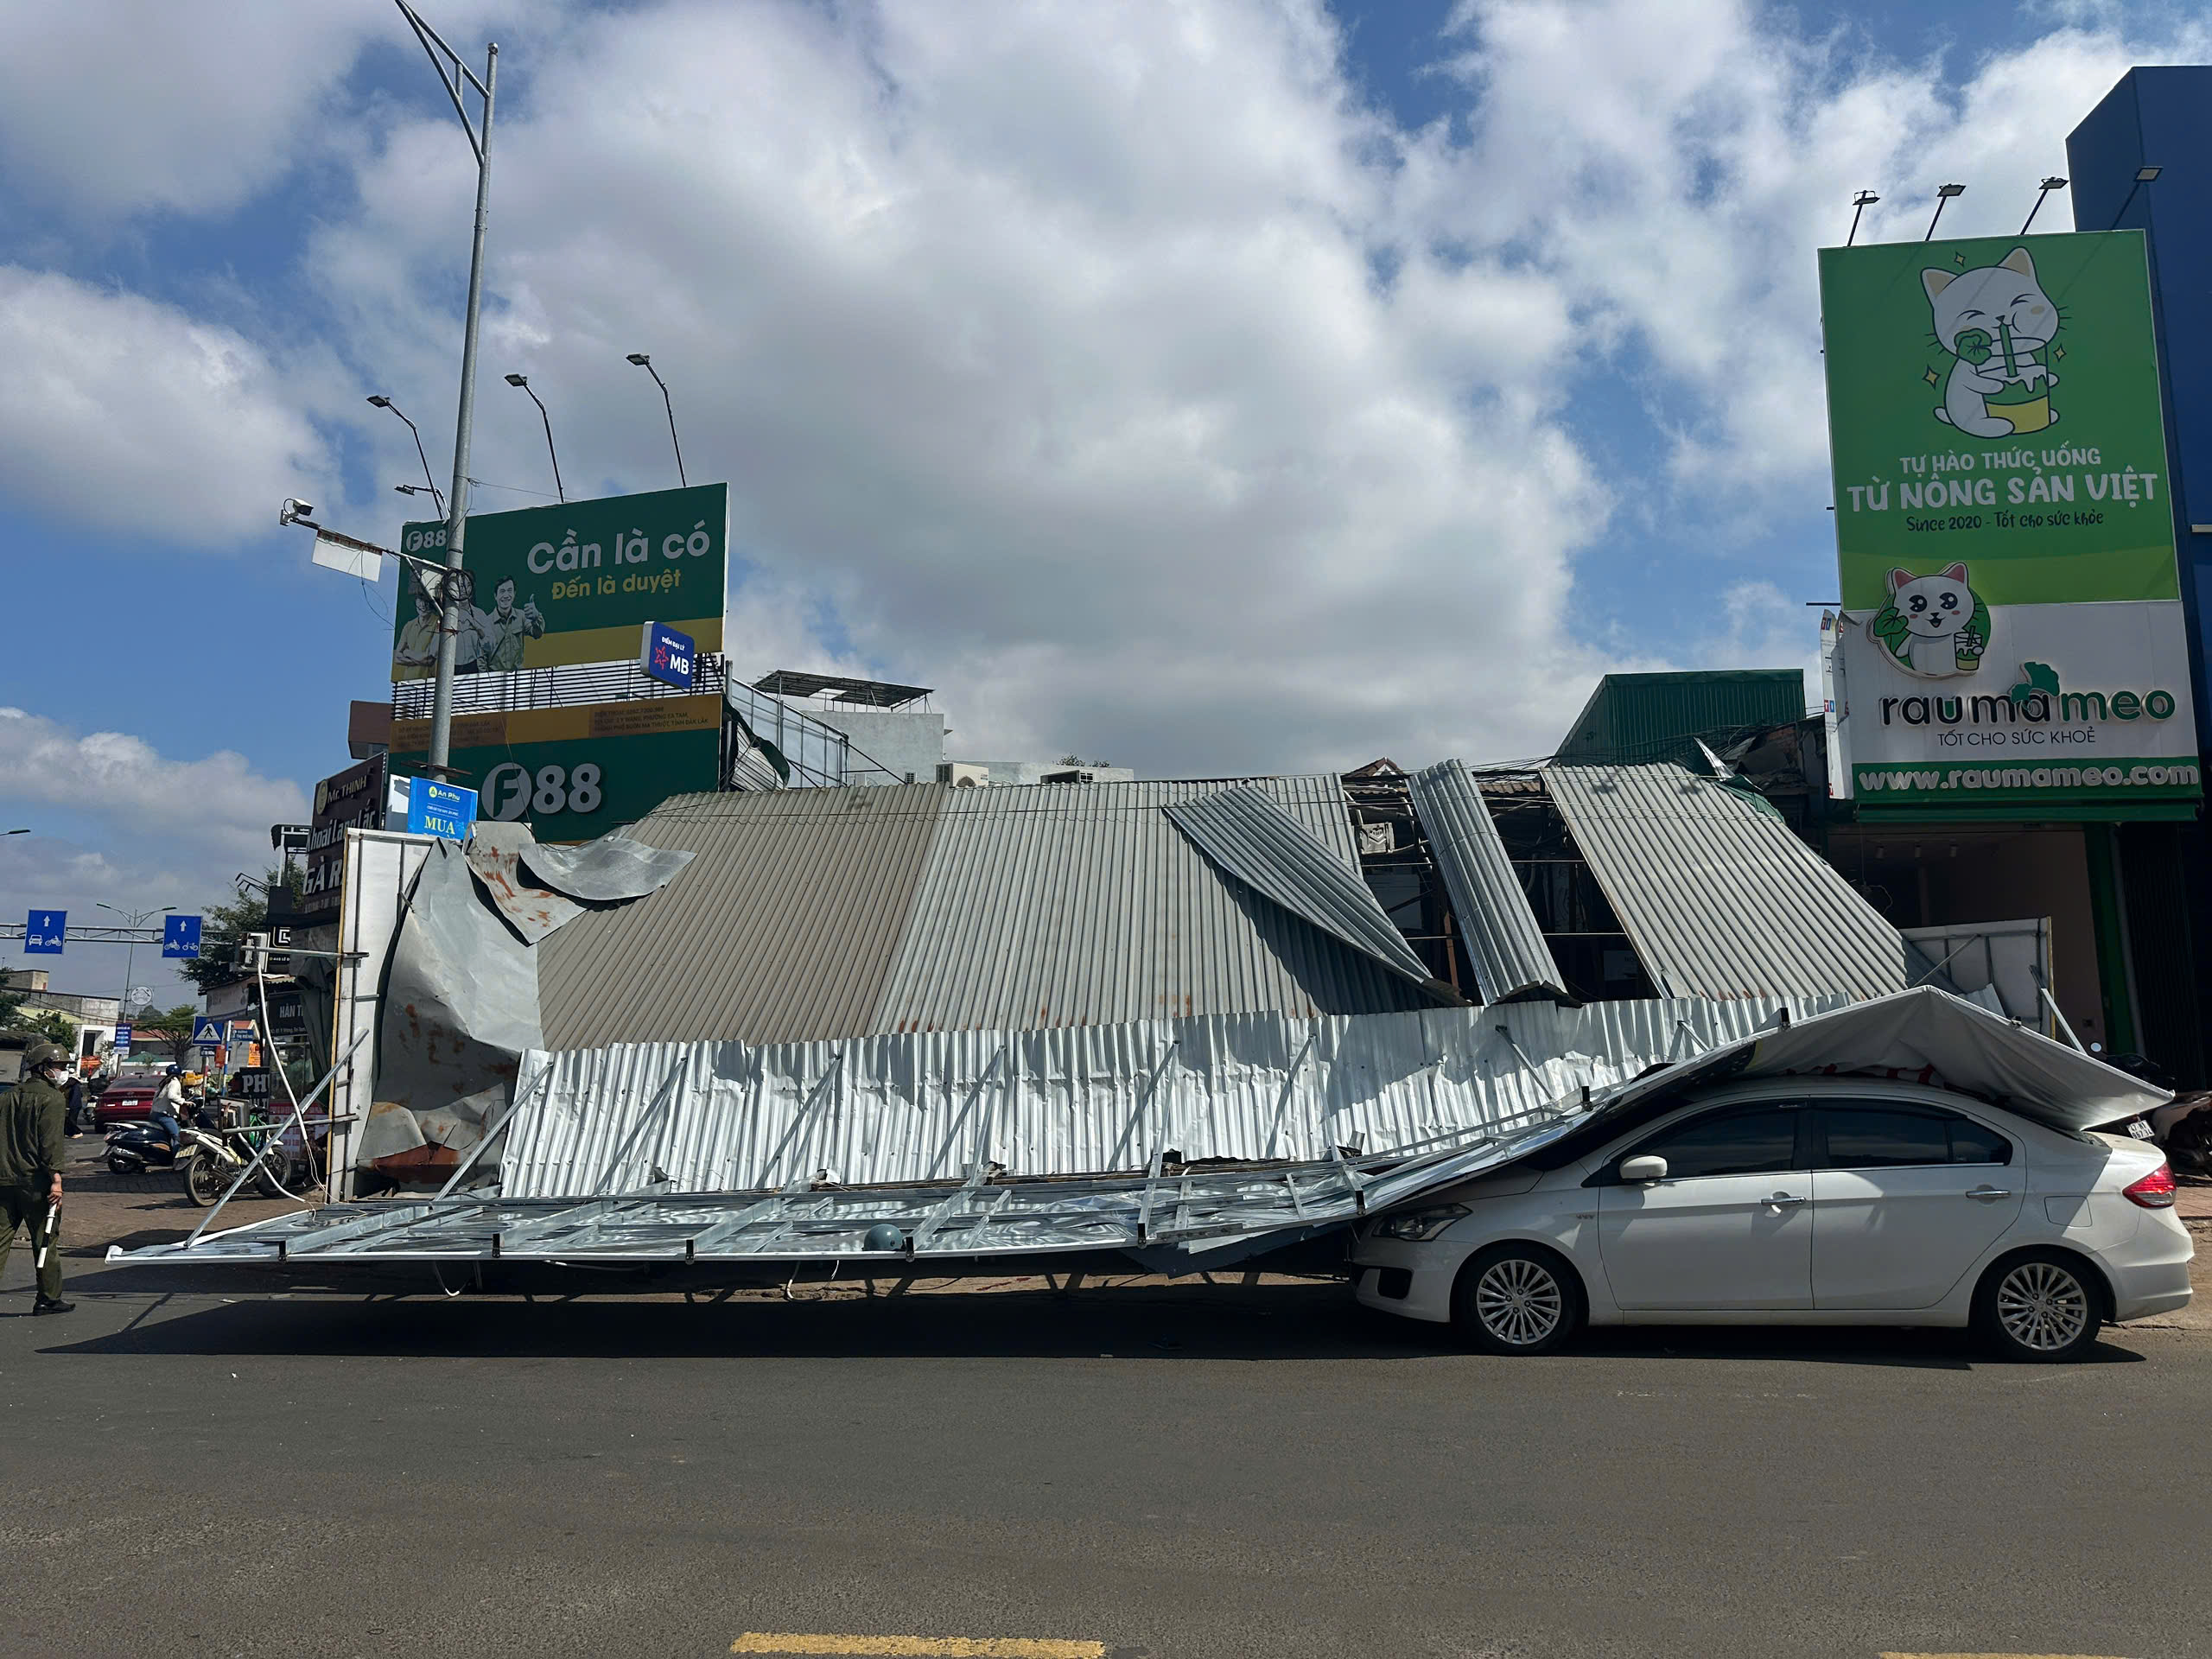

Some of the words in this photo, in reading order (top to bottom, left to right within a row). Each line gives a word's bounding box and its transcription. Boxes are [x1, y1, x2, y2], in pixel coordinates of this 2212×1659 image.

[1900, 454, 1926, 474] TỰ
[1931, 449, 1975, 472] HÀO
[1980, 443, 2037, 470] THỨC
[2042, 441, 2101, 467] UỐNG
[1847, 475, 1891, 512] TỪ
[1900, 470, 1997, 510] NÔNG
[2007, 465, 2075, 504] SẢN
[2084, 464, 2158, 508] VIỆT
[1906, 515, 1945, 532] Since
[1948, 514, 1982, 531] 2020
[1994, 509, 2016, 529] Tốt
[2019, 512, 2045, 528] cho
[2046, 508, 2071, 527] sức
[526, 529, 601, 575] Cần
[614, 528, 648, 565] là
[662, 520, 710, 560] có
[551, 575, 591, 601] Đến
[597, 575, 616, 594] là
[623, 569, 681, 597] duyệt
[670, 653, 690, 675] MB
[1937, 728, 1965, 747] TỐT
[1967, 731, 2006, 745] CHO
[2012, 728, 2045, 744] SỨC
[341, 775, 367, 798] THỊNH
[481, 762, 601, 821] F88
[1859, 764, 2199, 791] www.raumameo.com
[423, 816, 455, 835] MUA
[302, 855, 326, 896] GÀ
[328, 859, 342, 889] R
